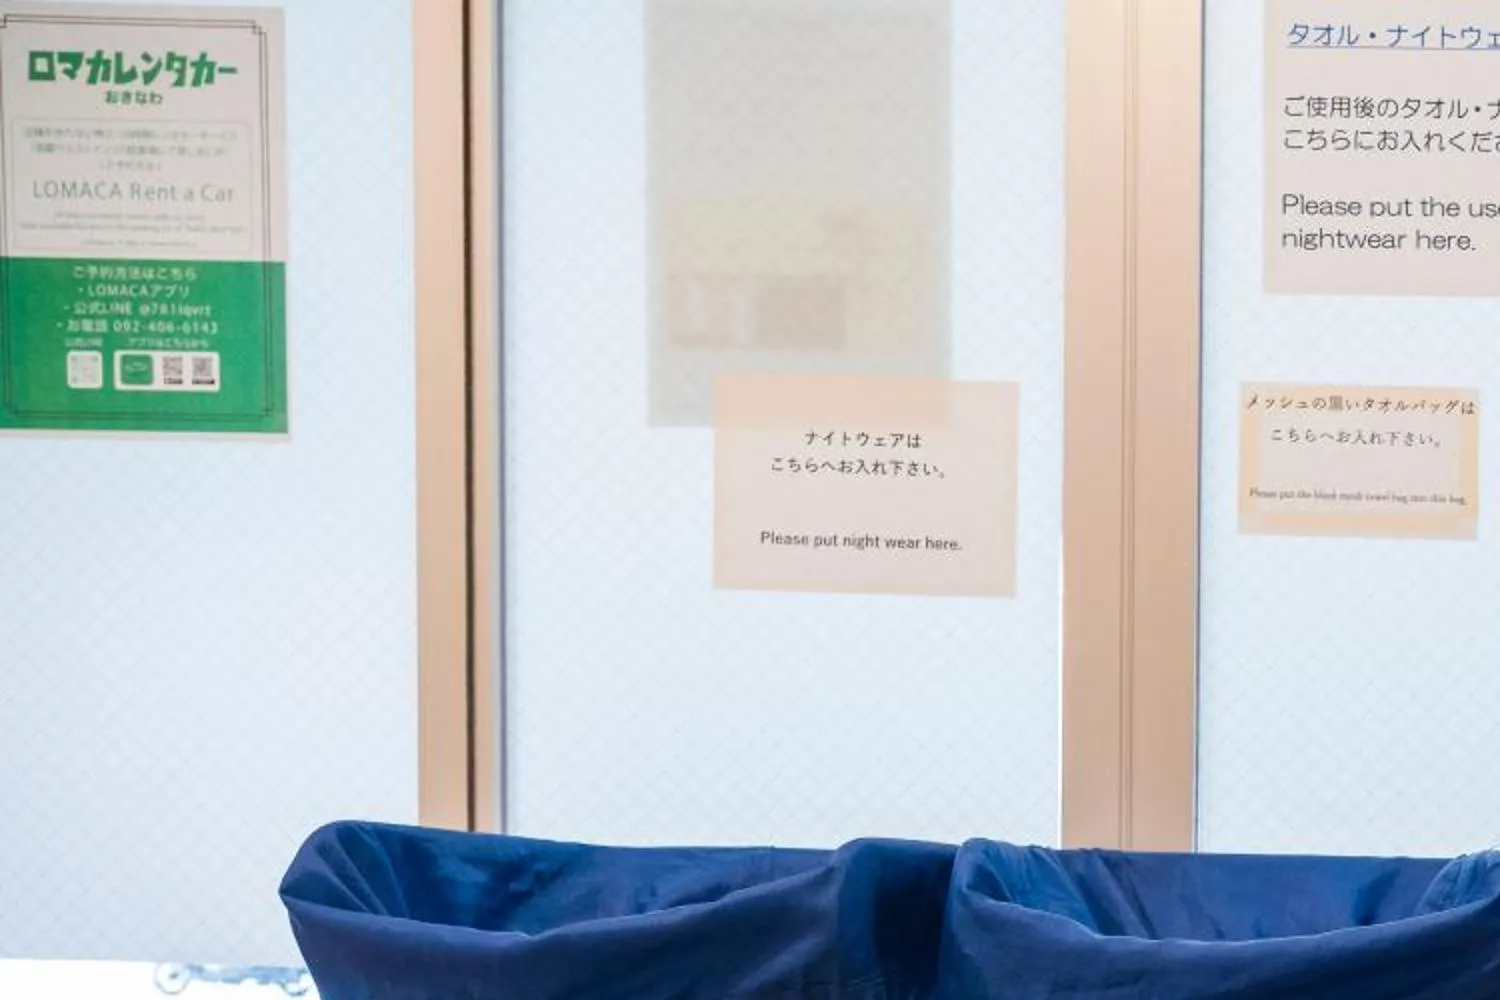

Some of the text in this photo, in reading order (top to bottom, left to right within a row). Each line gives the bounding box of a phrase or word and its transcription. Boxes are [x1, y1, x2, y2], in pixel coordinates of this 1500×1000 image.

[28, 50, 238, 87] ロマカレンタカー
[33, 180, 235, 203] LOMACA Rent a Car
[1281, 194, 1363, 217] Please
[1369, 197, 1413, 219] put
[1420, 196, 1461, 218] the
[1281, 228, 1477, 252] nightwear here.
[1246, 394, 1475, 415] メッシュの黒いタオルバッグは
[804, 430, 922, 449] ナイトウェアは
[1271, 428, 1441, 448] こちらへお入れ下さい。
[771, 457, 945, 478] こちらへお入れ下さい。
[760, 531, 962, 550] Please put night wear here.
